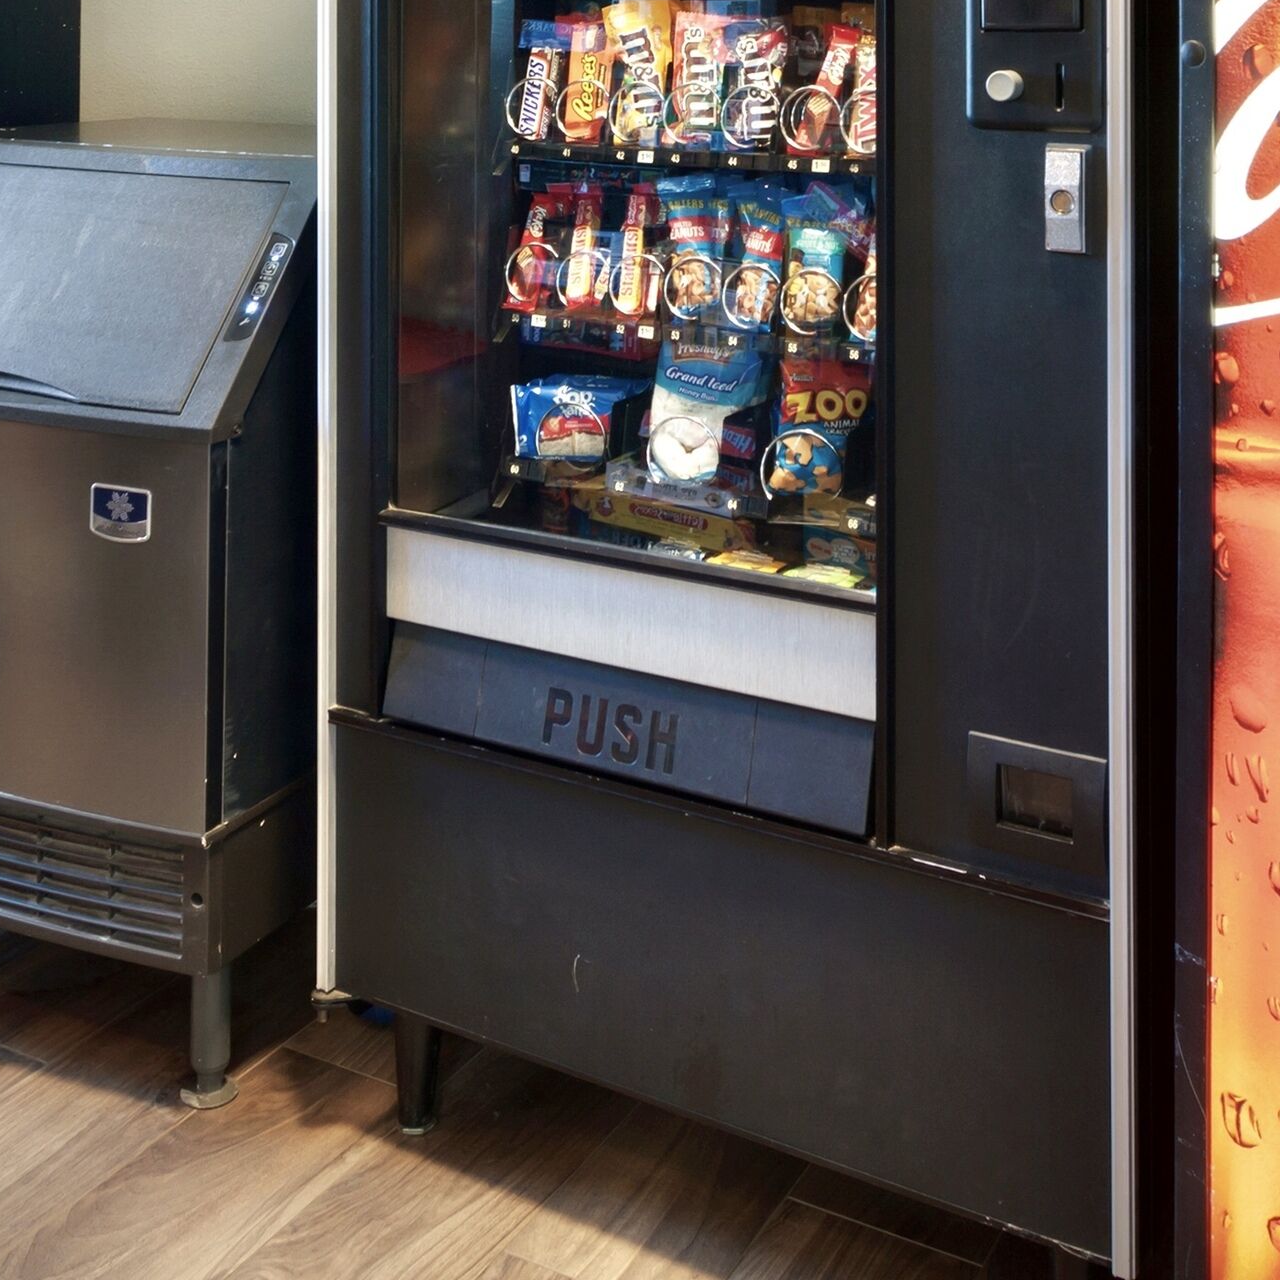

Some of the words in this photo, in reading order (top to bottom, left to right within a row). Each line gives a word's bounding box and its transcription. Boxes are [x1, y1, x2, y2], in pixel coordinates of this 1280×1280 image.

[519, 59, 545, 134] SNICKERS
[562, 148, 571, 157] 41
[615, 151, 625, 161] 42
[670, 154, 681, 164] 43
[727, 156, 738, 166] 44
[787, 160, 798, 170] 45
[562, 319, 571, 328] 51
[616, 324, 625, 334] 52
[671, 331, 680, 340] 53
[788, 343, 797, 353] 55
[849, 350, 859, 360] 56
[665, 365, 709, 387] Grand
[707, 375, 738, 393] Iced
[678, 386, 700, 399] Honey
[786, 389, 867, 425] ZOO
[510, 465, 520, 475] 60
[614, 481, 624, 492] 62
[727, 499, 738, 510] 64
[541, 686, 681, 775] PUSH
